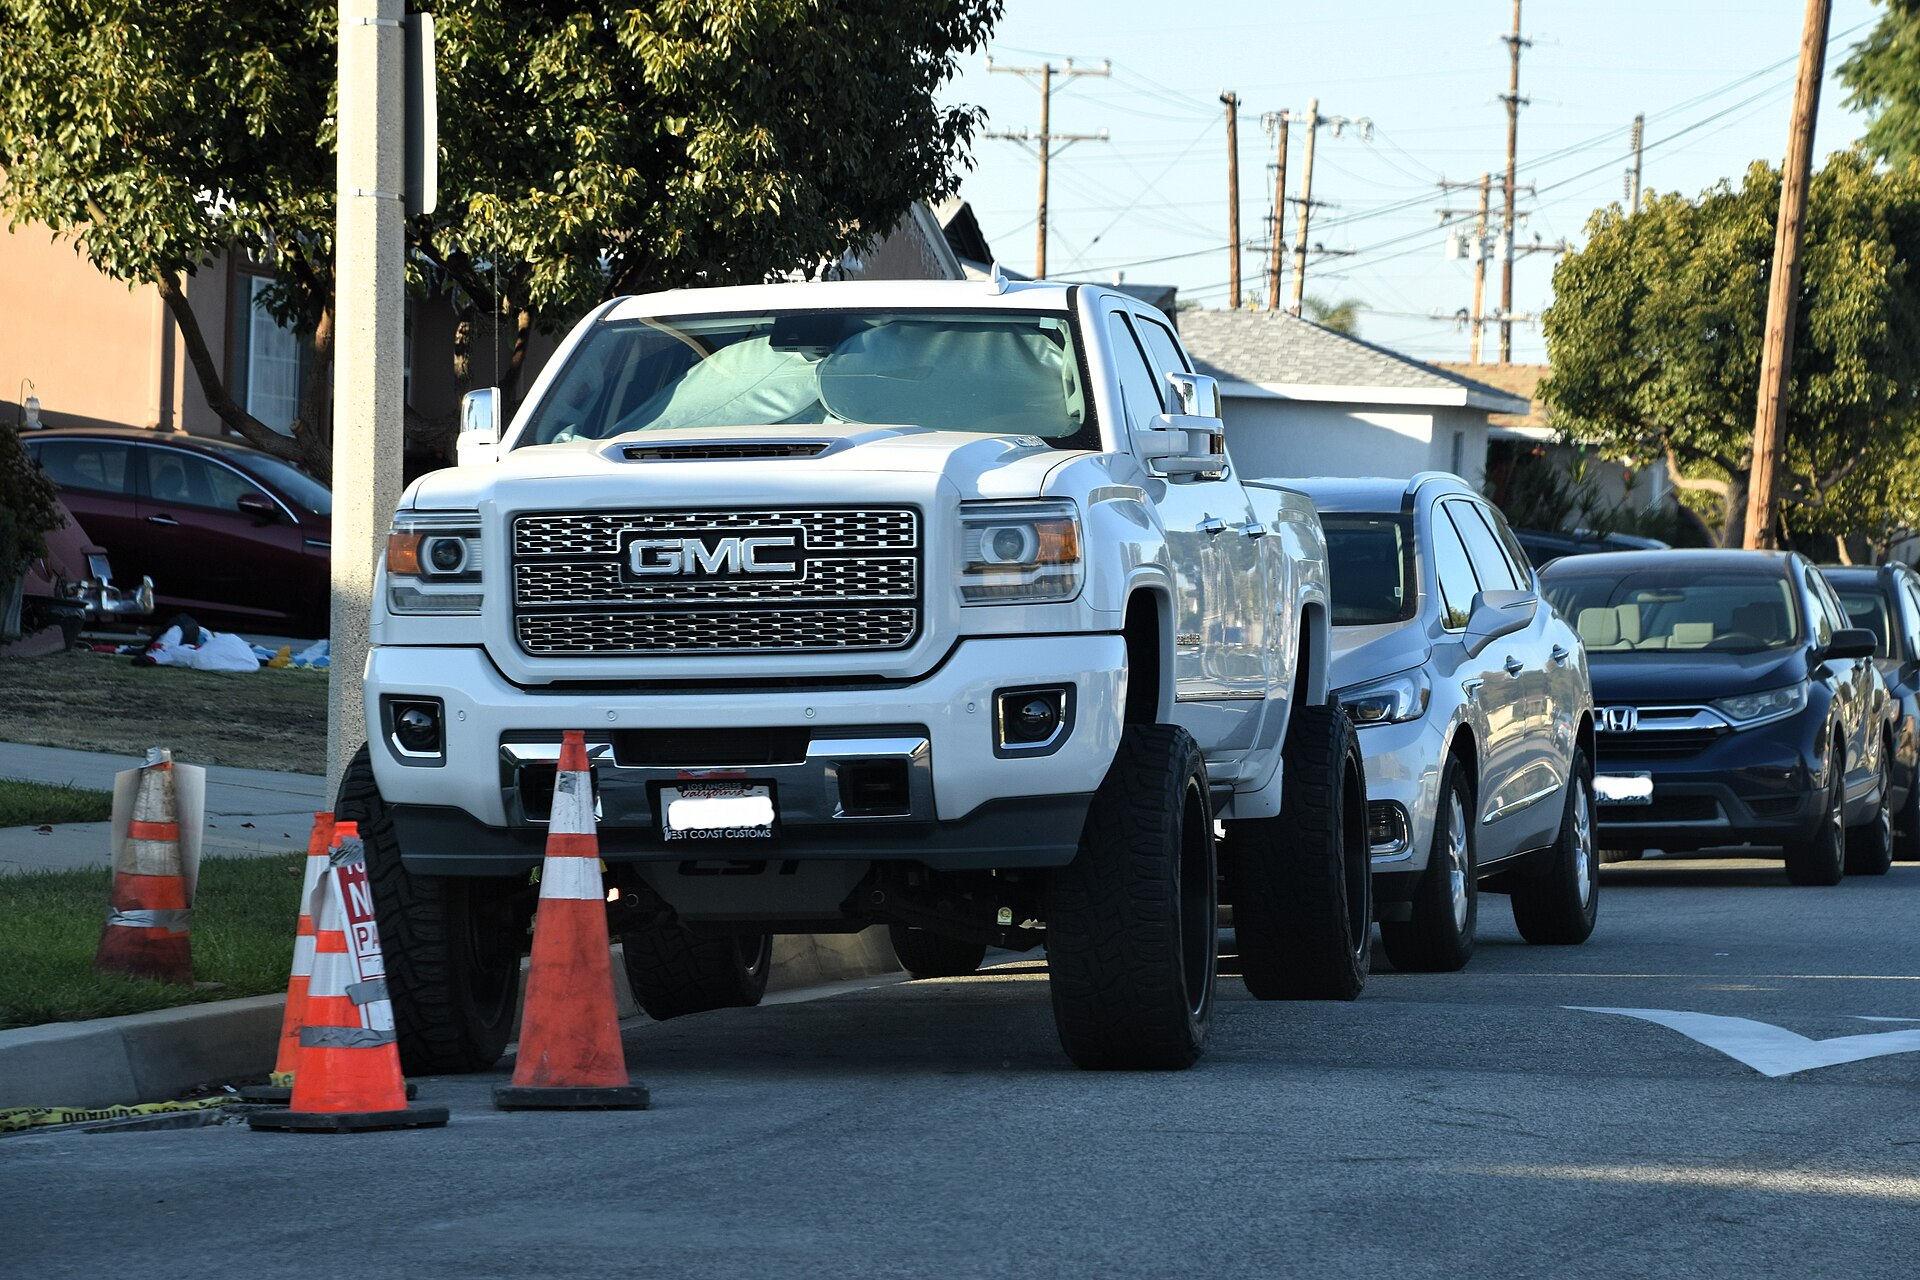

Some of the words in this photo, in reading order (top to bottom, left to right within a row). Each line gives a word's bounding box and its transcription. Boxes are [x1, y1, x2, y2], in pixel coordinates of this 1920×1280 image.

[629, 537, 796, 576] GMC
[687, 783, 703, 792] LOS
[705, 782, 743, 791] ANGELES
[689, 829, 724, 839] COAST
[725, 828, 771, 839] CUSTOMS
